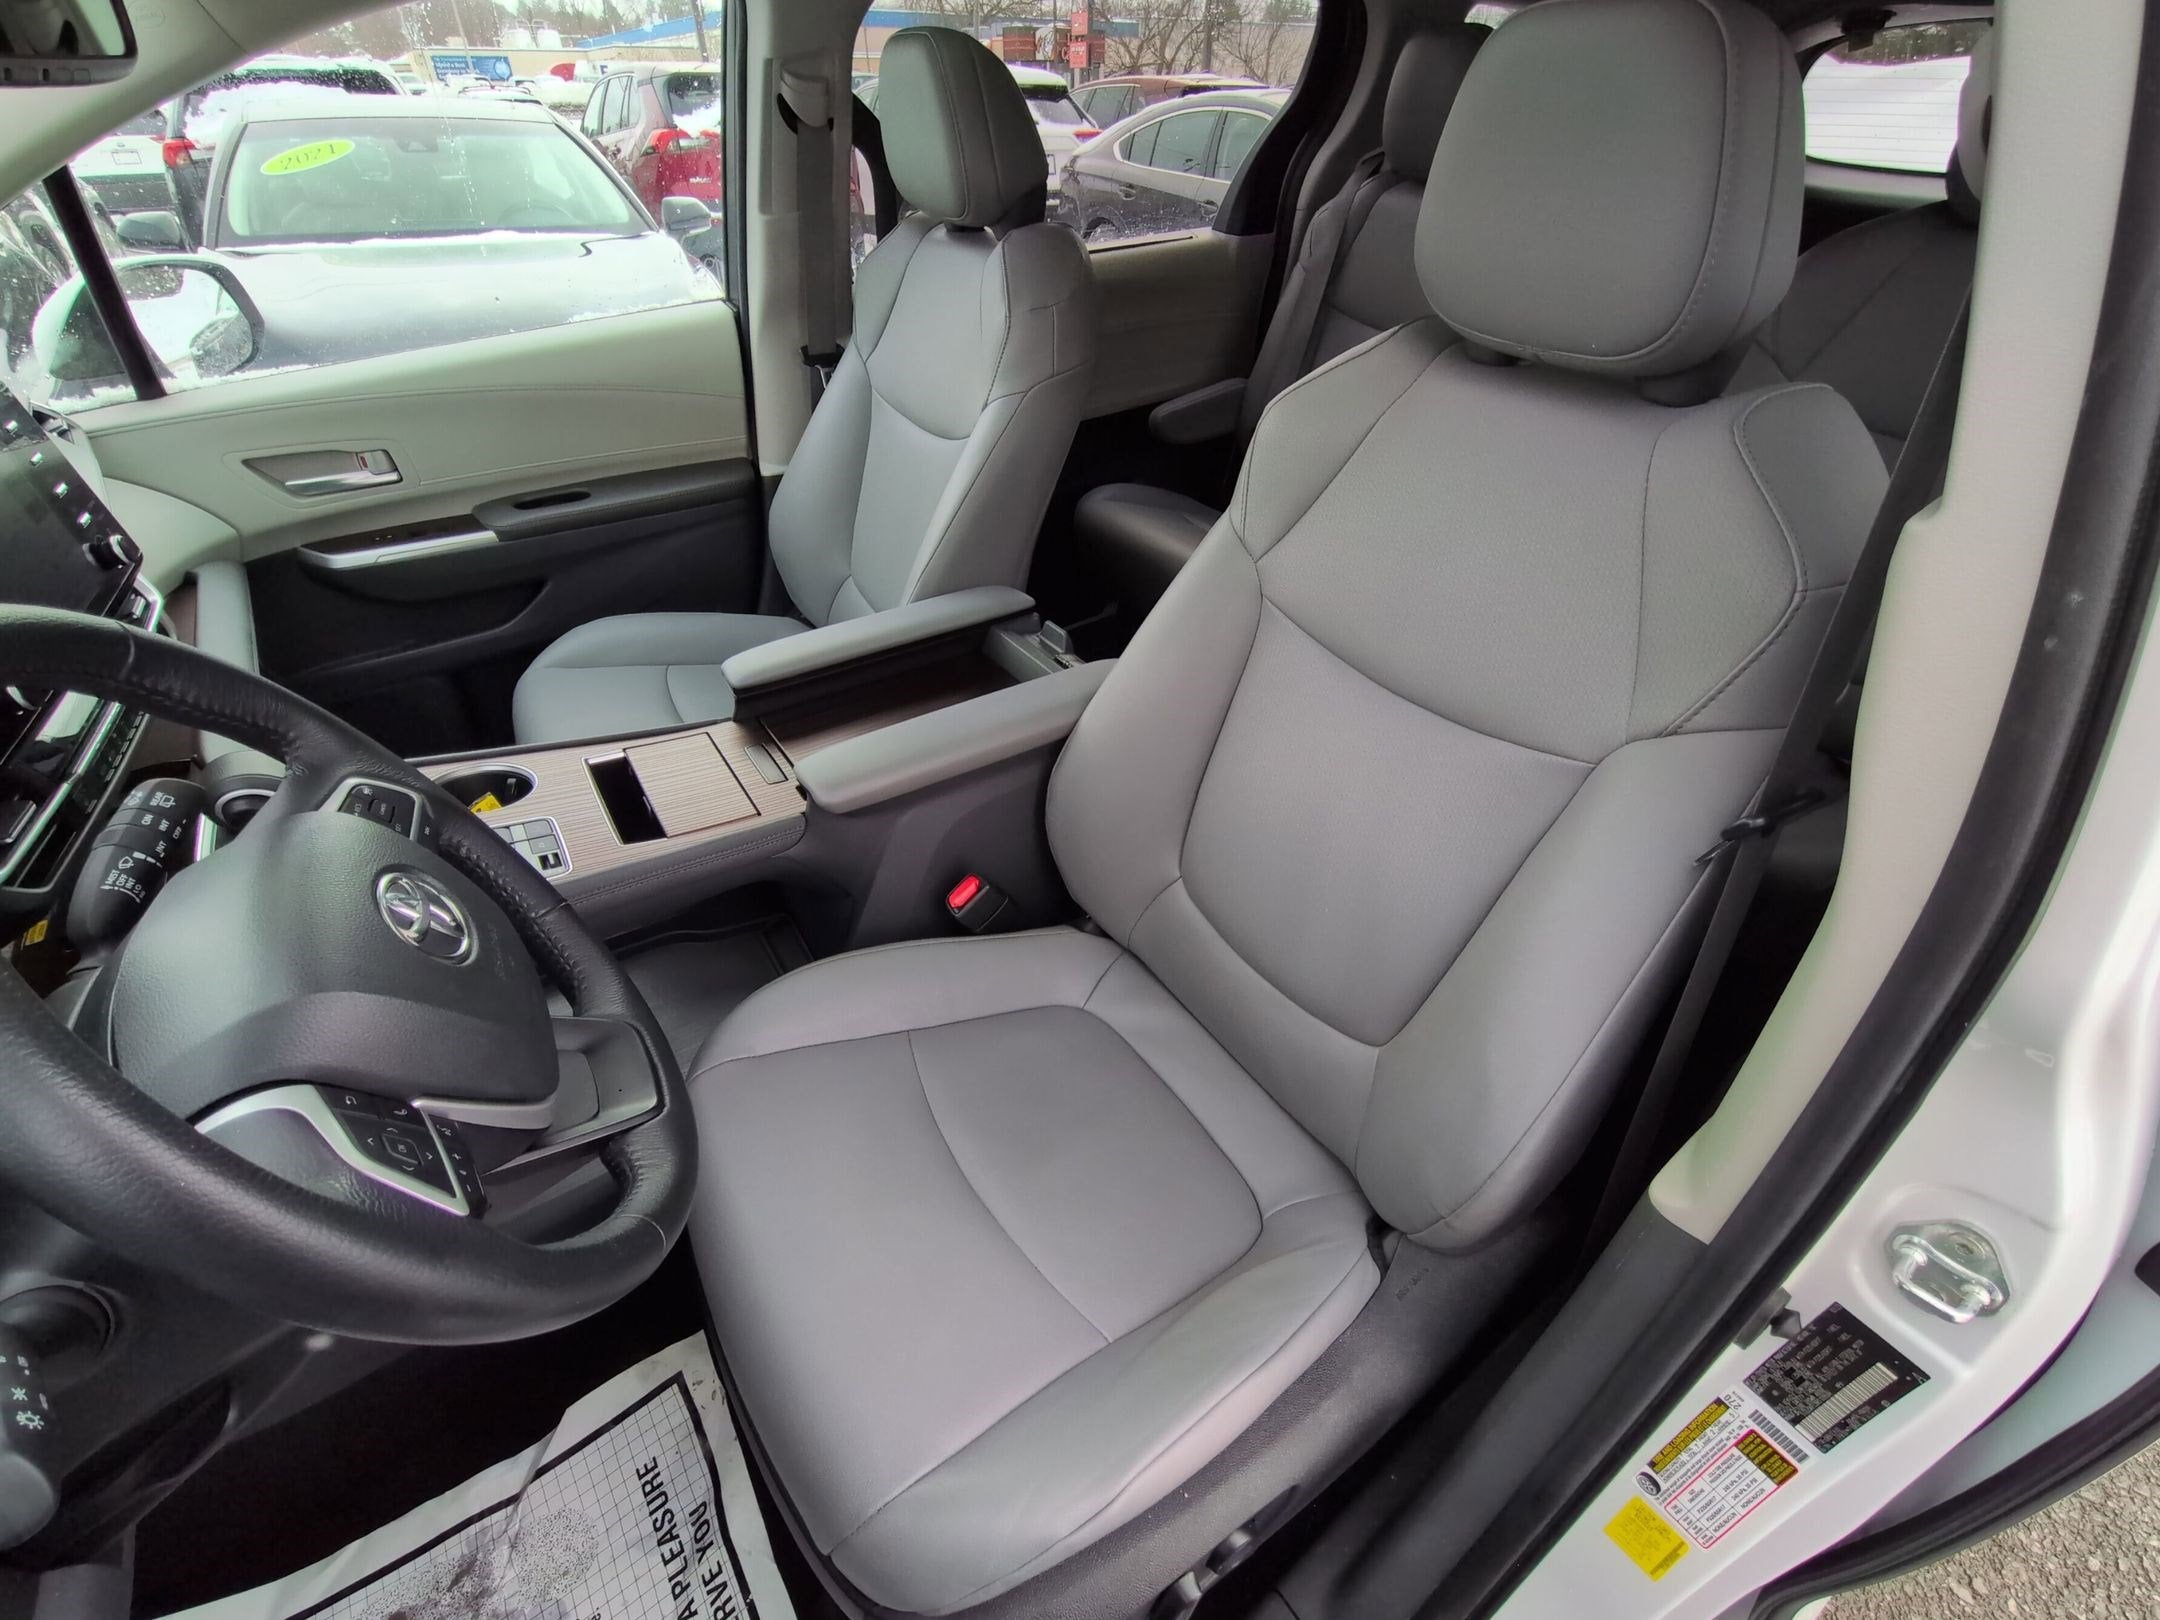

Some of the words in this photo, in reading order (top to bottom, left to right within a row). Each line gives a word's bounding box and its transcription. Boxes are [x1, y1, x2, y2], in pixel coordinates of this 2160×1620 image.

[280, 143, 336, 170] 2021
[141, 814, 154, 825] ON
[158, 819, 170, 831] INT
[116, 873, 128, 886] OFF
[636, 1456, 691, 1600] PLEASURE
[689, 1500, 714, 1566] YOU
[701, 1560, 738, 1620] RVE
